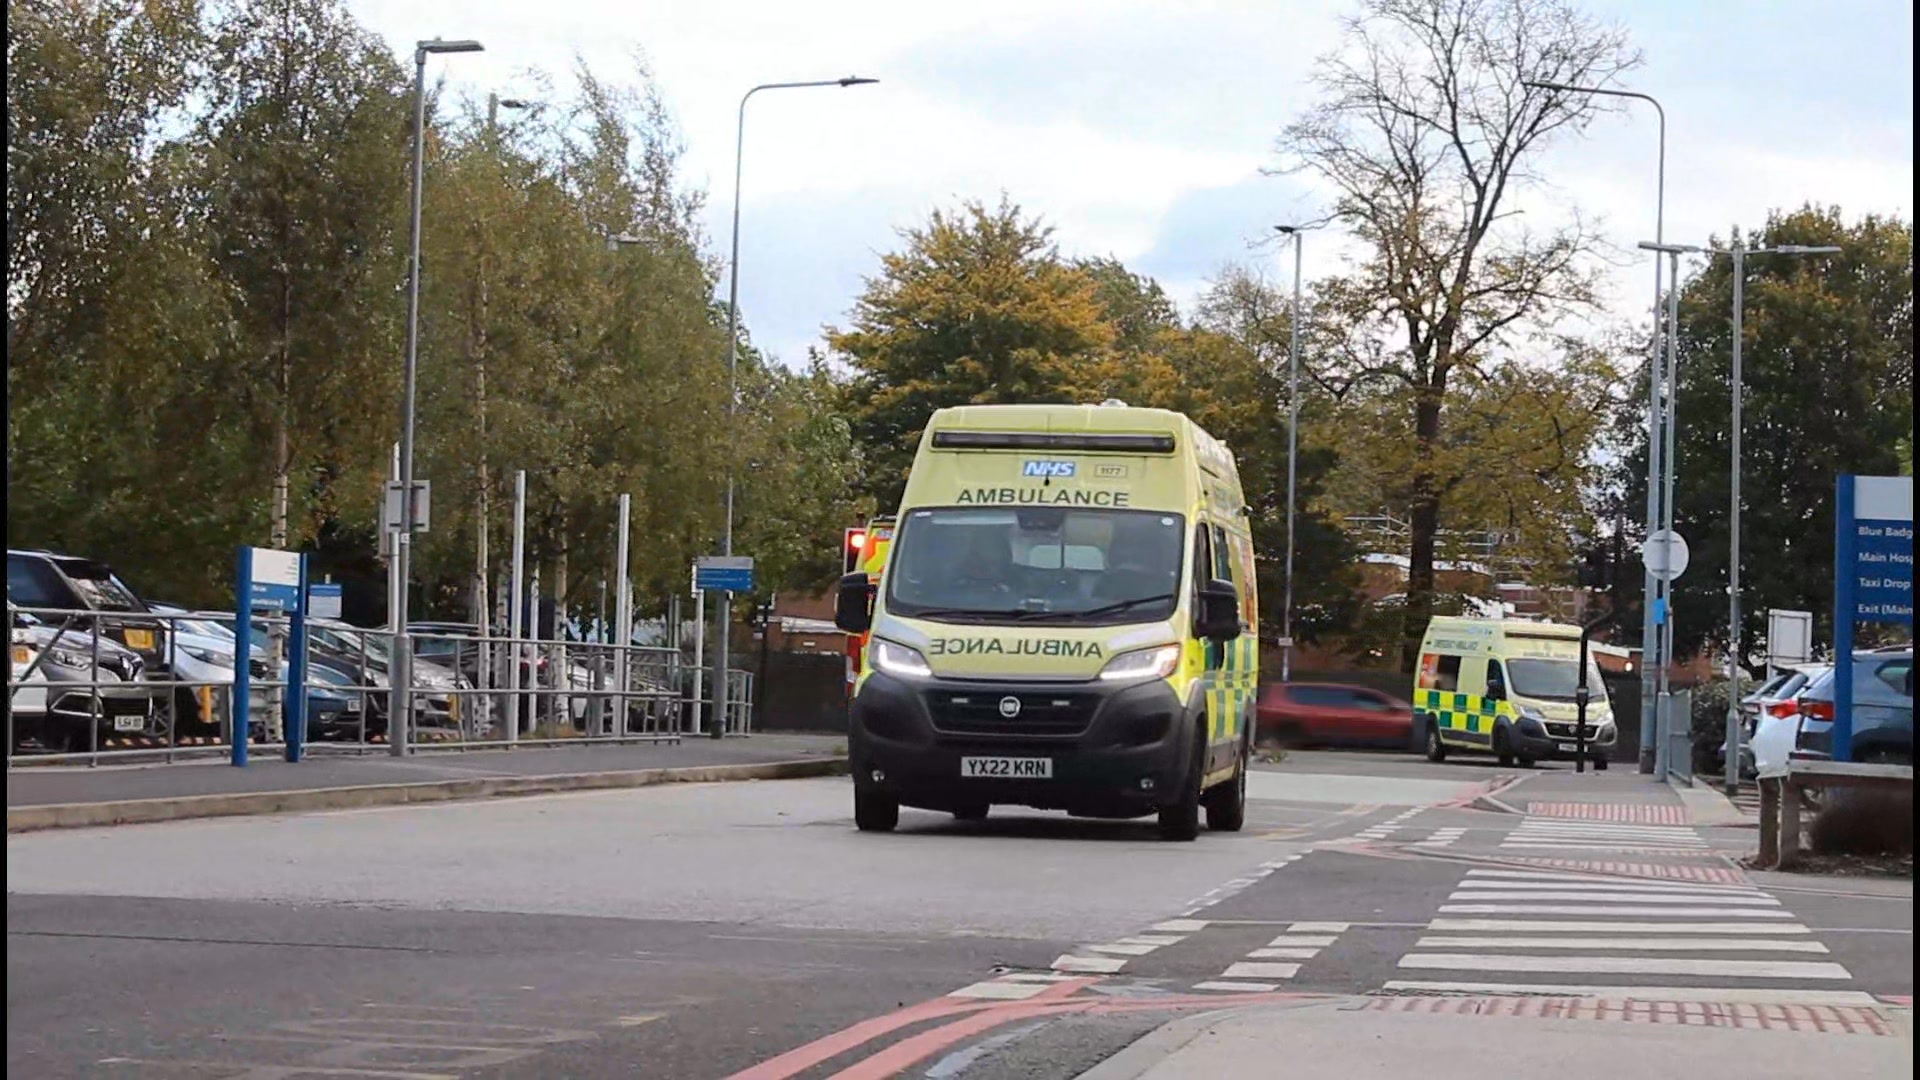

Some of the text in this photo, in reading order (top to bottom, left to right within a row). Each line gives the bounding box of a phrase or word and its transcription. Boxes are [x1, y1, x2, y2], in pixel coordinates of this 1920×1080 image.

[1024, 461, 1075, 477] NHS
[957, 488, 1129, 507] AMBULANCE
[1858, 526, 1883, 536] Blue
[1858, 552, 1887, 562] Main
[1859, 577, 1911, 591] Taxi Drop
[1858, 603, 1913, 615] Exit (Main
[968, 759, 1046, 776] YX22 KRN
